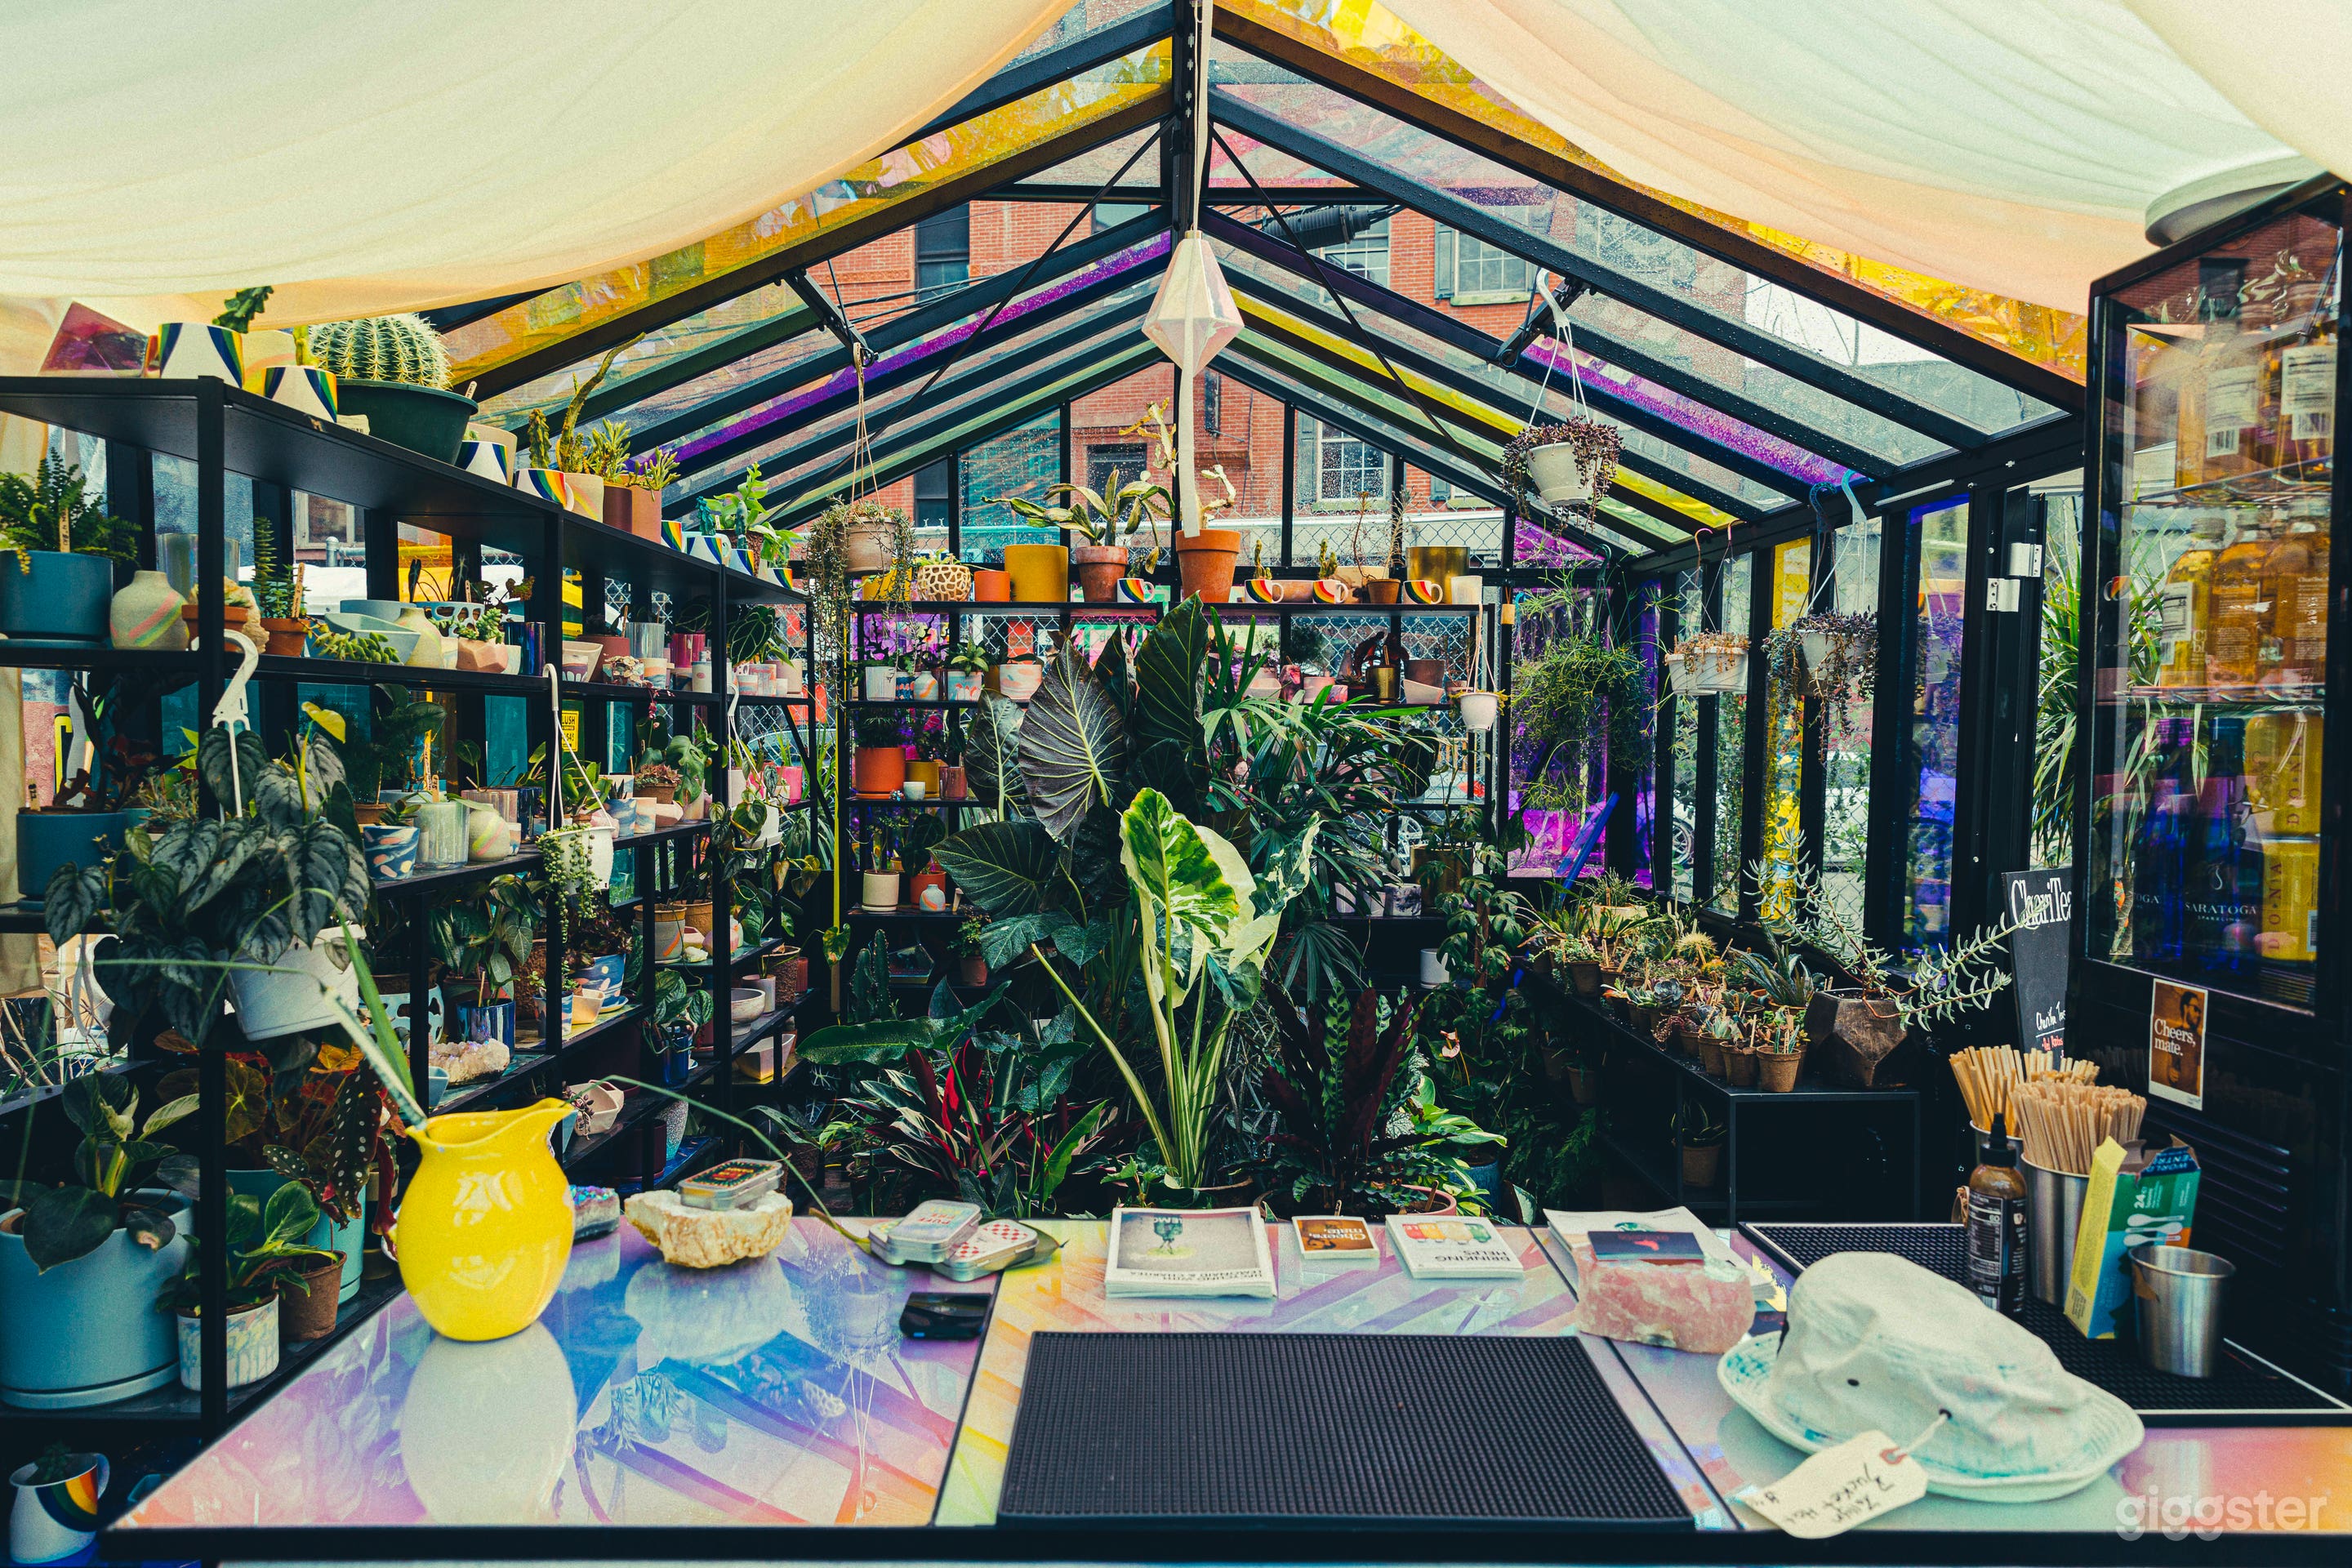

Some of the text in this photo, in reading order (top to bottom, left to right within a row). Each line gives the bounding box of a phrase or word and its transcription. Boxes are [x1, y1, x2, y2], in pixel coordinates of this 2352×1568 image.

[2185, 902, 2257, 915] SARATOGA
[2154, 1018, 2196, 1048] Cheers,
[2154, 1037, 2184, 1057] mate.
[1308, 1232, 1366, 1241] Cheers,
